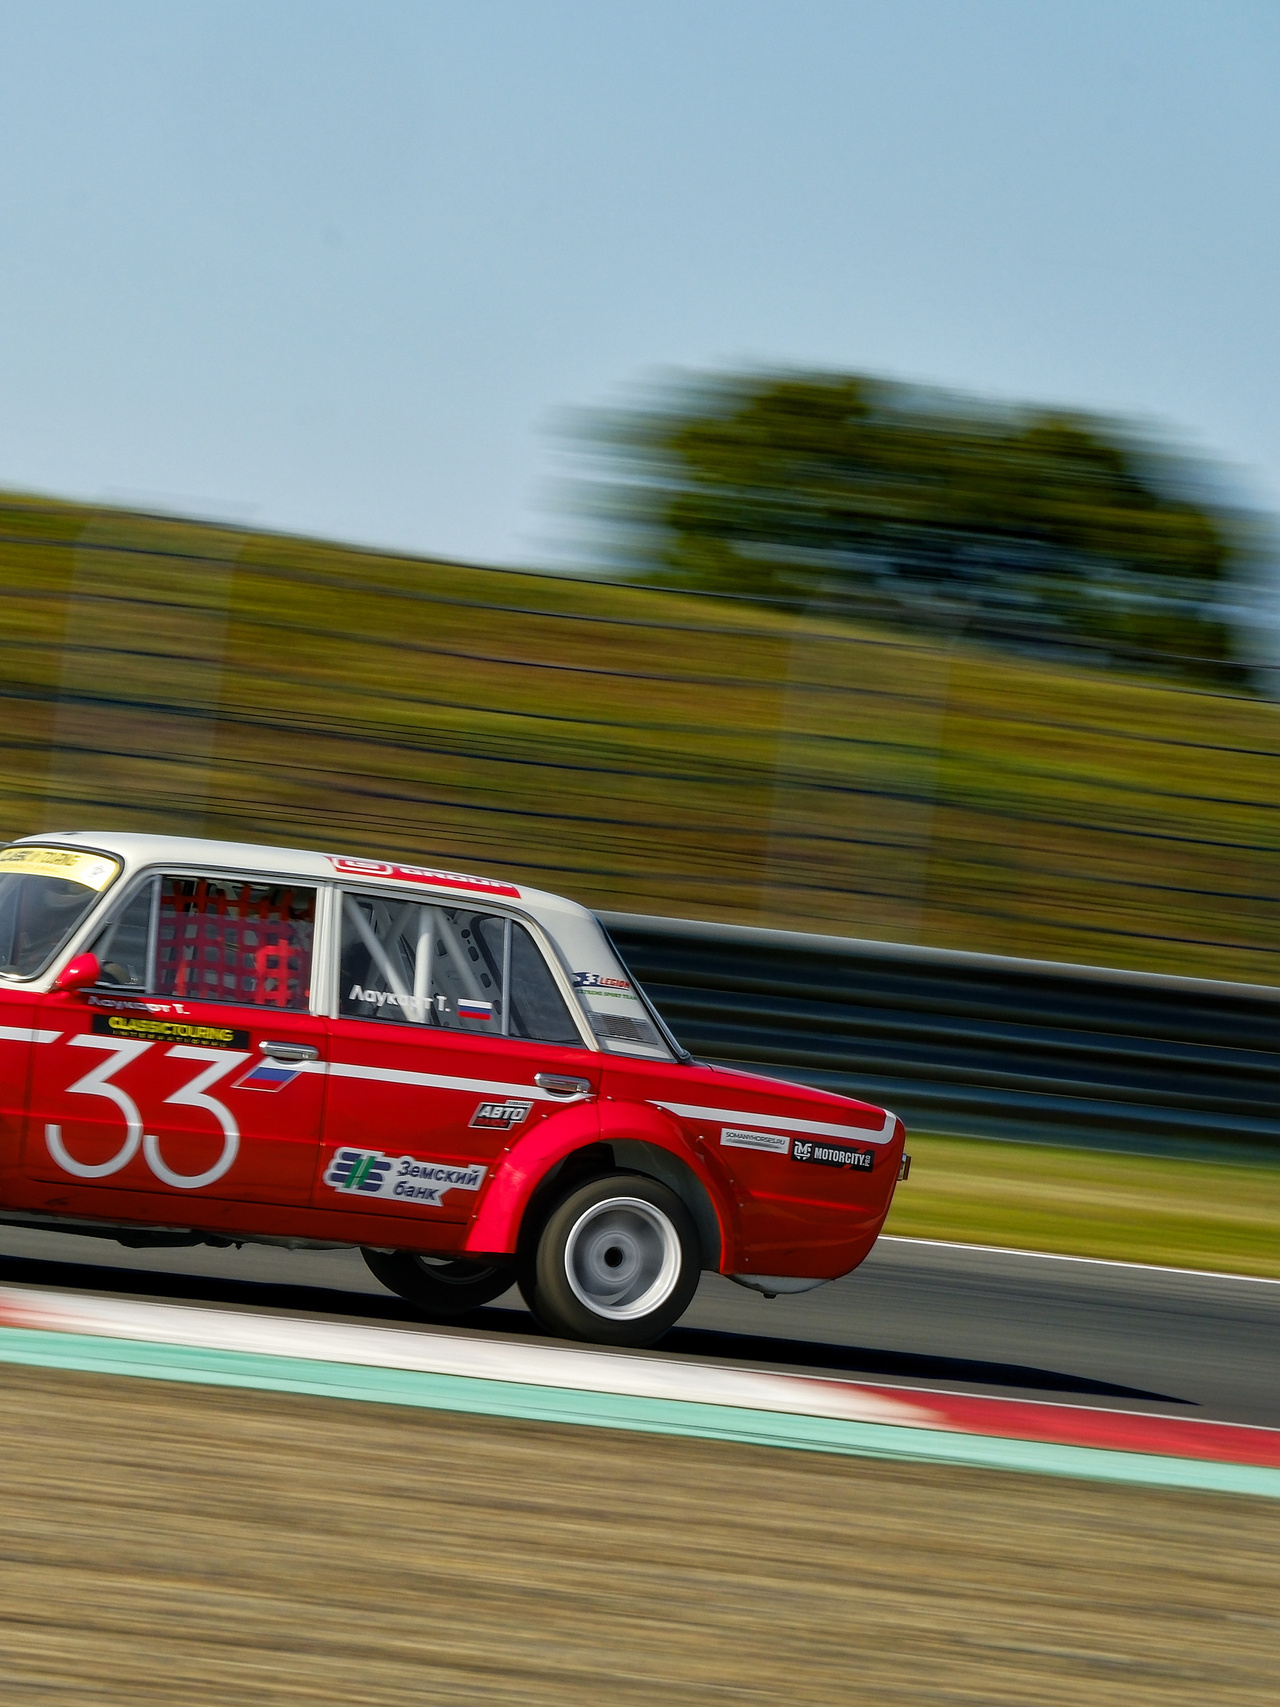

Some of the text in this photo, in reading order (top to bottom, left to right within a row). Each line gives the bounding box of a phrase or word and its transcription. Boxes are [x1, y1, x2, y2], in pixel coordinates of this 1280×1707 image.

[44, 1033, 254, 1189] 33
[477, 1105, 526, 1120] АВТО
[396, 1160, 481, 1186] Земский
[392, 1180, 441, 1201] банк
